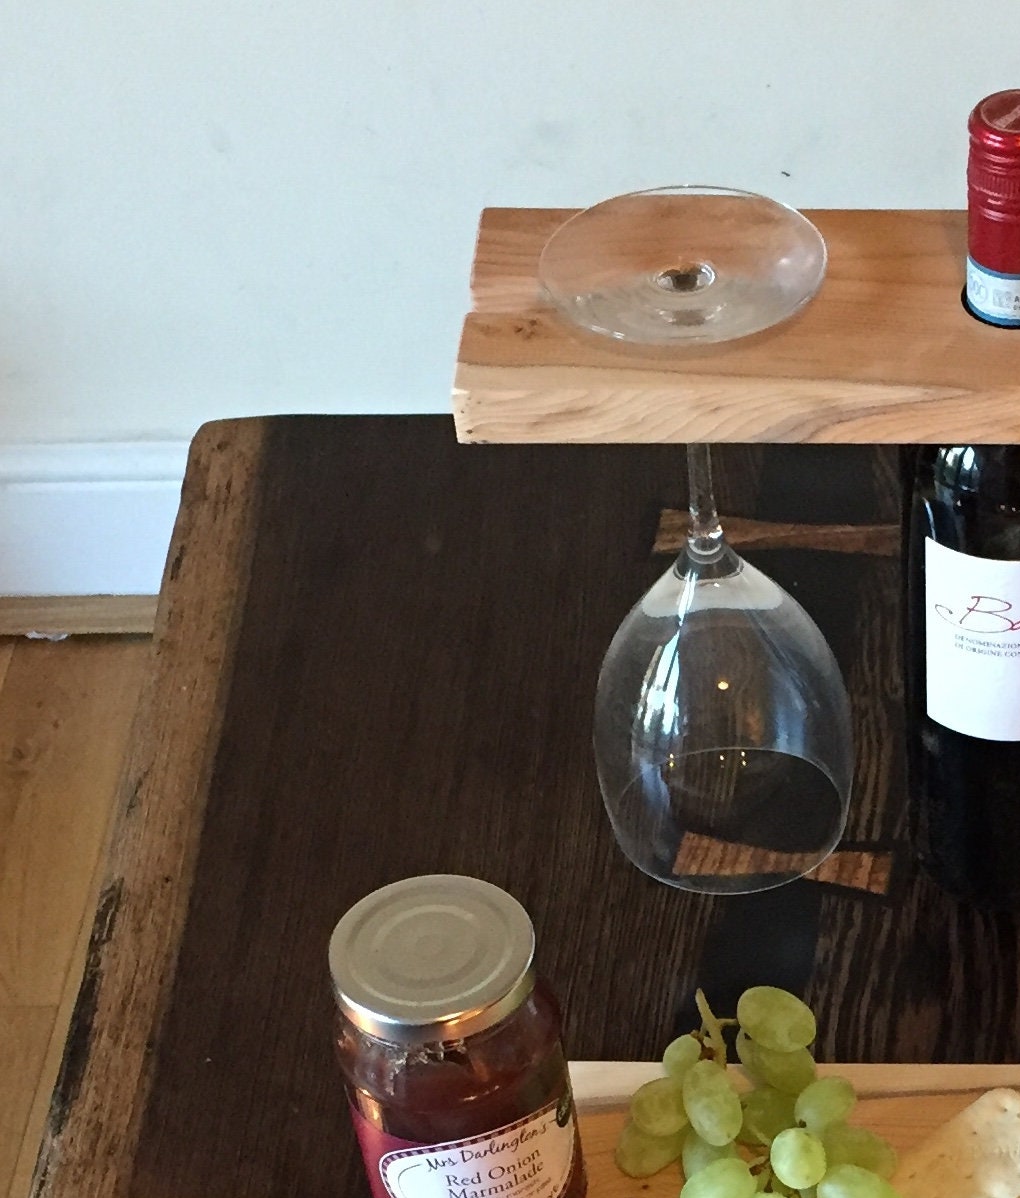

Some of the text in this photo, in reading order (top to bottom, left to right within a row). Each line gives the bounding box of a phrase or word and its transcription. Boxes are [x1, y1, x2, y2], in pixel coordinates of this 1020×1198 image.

[425, 1156, 458, 1173] Mrs
[445, 1149, 541, 1188] Red Onion
